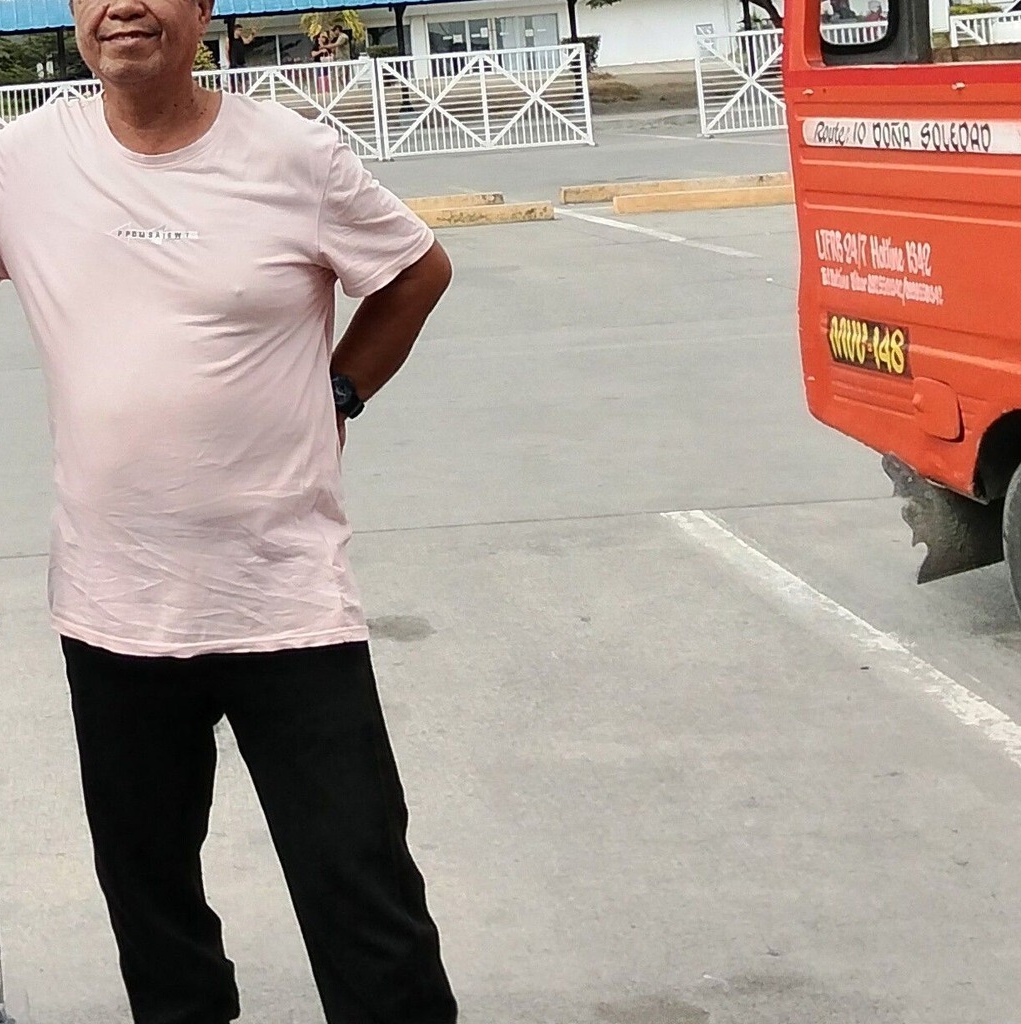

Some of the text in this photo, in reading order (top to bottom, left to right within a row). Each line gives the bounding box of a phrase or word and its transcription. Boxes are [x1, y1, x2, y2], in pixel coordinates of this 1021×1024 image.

[852, 122, 867, 145] 10
[872, 122, 912, 149] DOÑA
[920, 122, 992, 152] SOLEDAD
